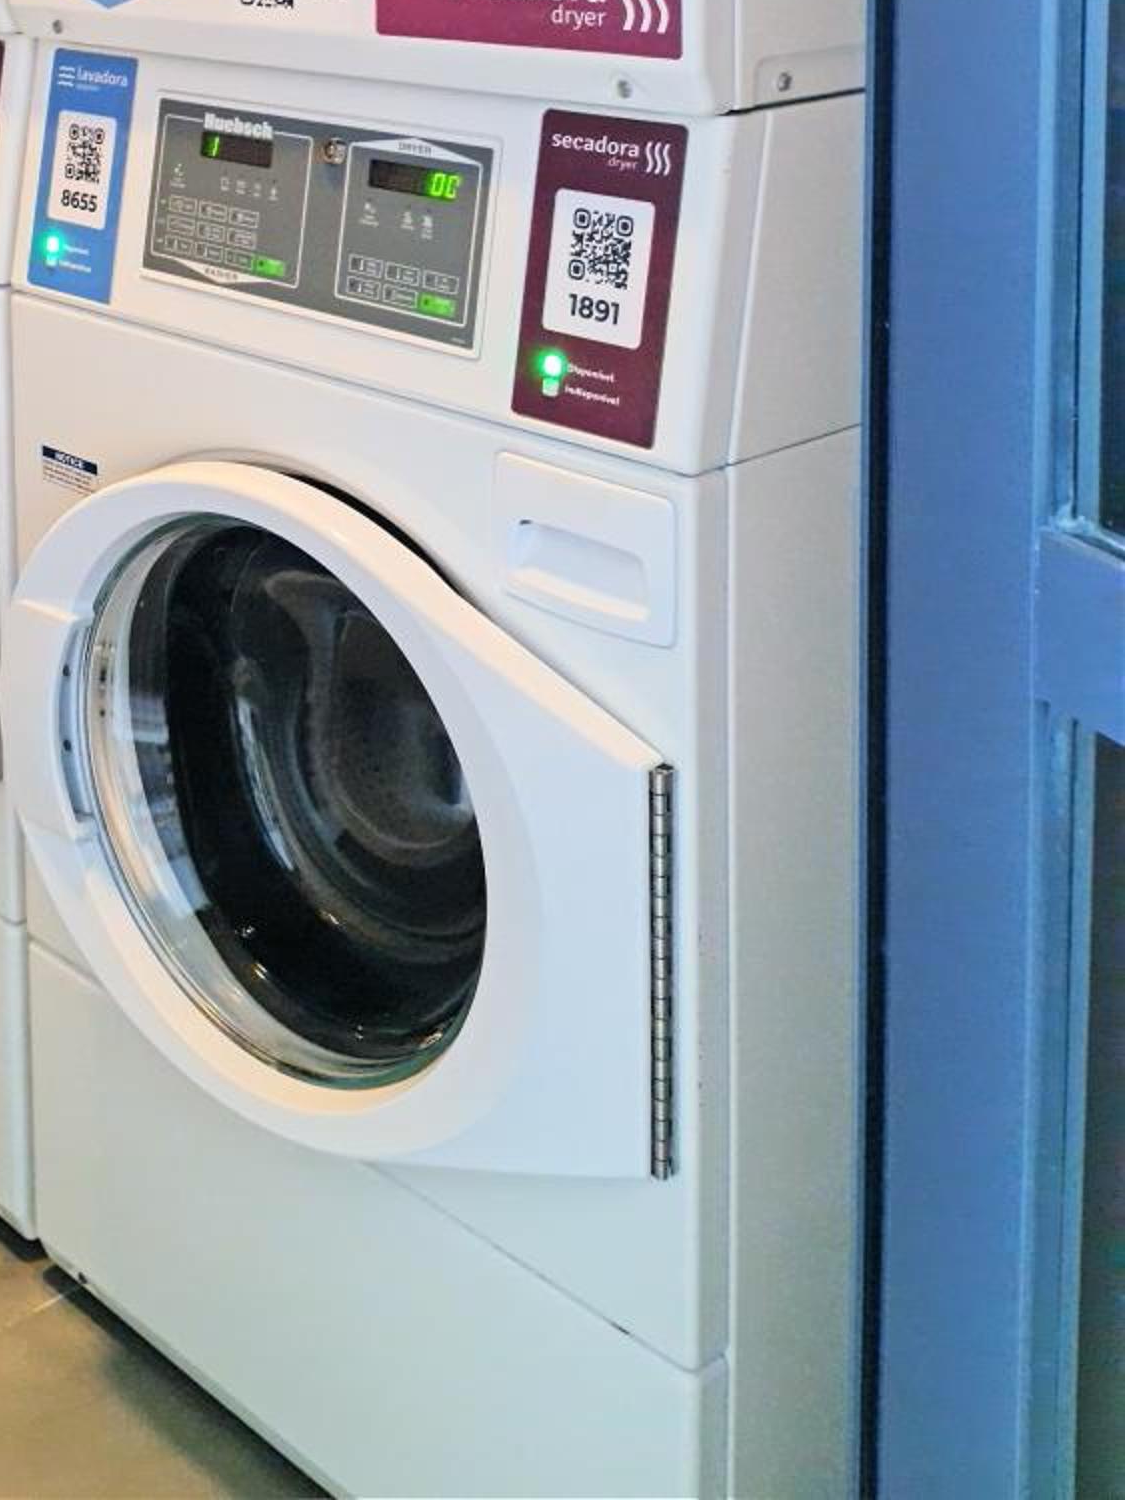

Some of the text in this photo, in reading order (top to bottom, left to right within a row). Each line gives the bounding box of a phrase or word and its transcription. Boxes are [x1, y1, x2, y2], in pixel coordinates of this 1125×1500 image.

[550, 4, 607, 31] dryer
[76, 66, 129, 88] lavadora
[203, 112, 274, 141] Huebsch
[551, 133, 640, 158] secadora
[607, 156, 638, 171] dryer
[61, 189, 98, 212] 8655
[569, 293, 621, 326] 1891
[55, 451, 83, 469] NOTICE
